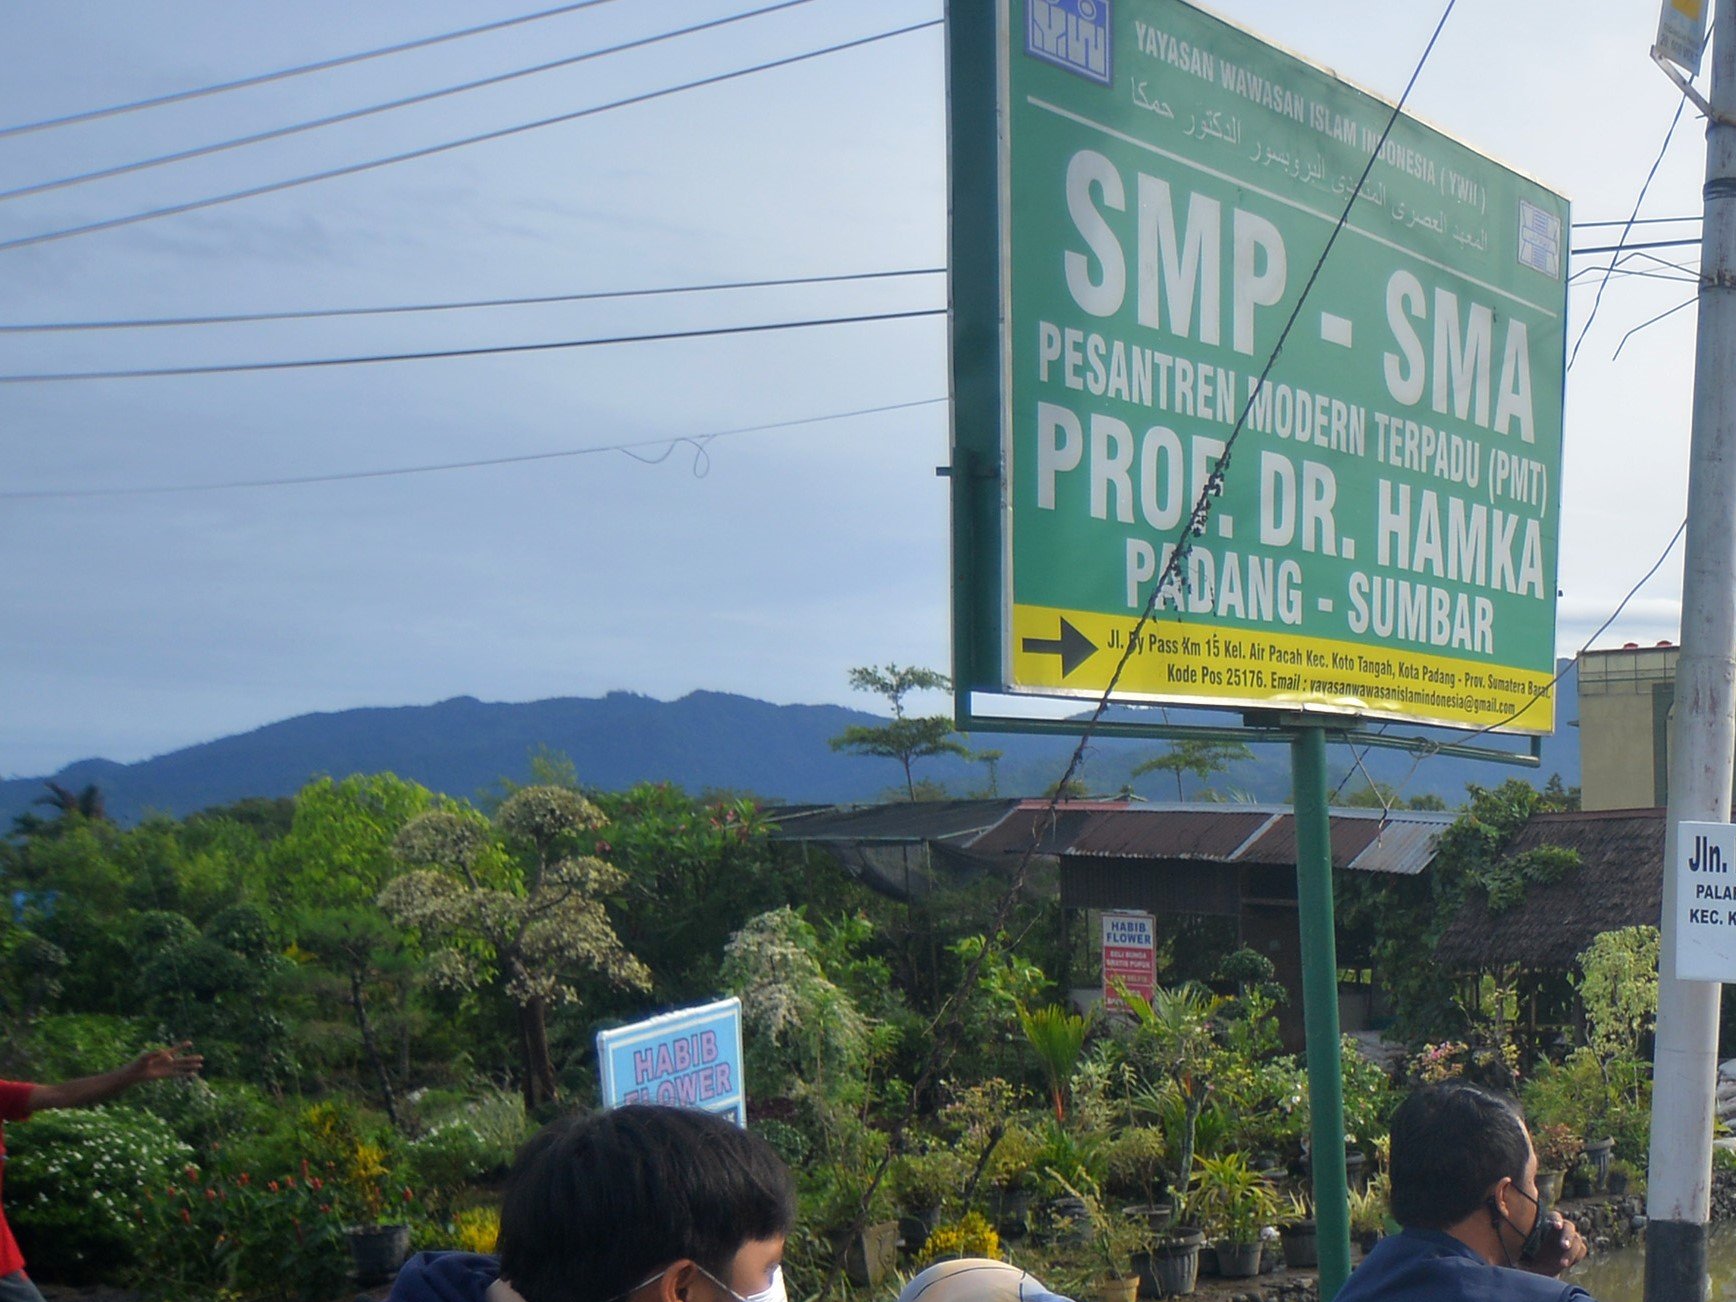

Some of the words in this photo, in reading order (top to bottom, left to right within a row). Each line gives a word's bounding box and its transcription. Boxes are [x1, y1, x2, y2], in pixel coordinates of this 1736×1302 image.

[1135, 21, 1214, 82] YAYASAN
[1220, 59, 1304, 123] WAWASAN
[1310, 102, 1357, 147] ISLAM
[1363, 128, 1435, 186] INDONESIA
[1064, 150, 1287, 356] SMP
[1384, 269, 1535, 444] SMA
[1039, 320, 1235, 425] PESANTREN
[1247, 376, 1366, 457] MODERN
[1374, 411, 1480, 488] TERPADU
[1488, 448, 1547, 518] (PMT)
[1037, 400, 1234, 539] PROF.
[1260, 450, 1355, 560] DR.
[1377, 478, 1545, 600] HAMKA
[1126, 538, 1302, 625] PADANG
[1348, 572, 1494, 655] SUMBAR
[1107, 629, 1124, 649] Jl.
[1149, 633, 1178, 654] Pass
[1183, 637, 1201, 657] Km
[1205, 638, 1220, 658] 15
[1224, 640, 1246, 660] Kel.
[1250, 642, 1265, 661] Air
[1269, 643, 1302, 666] Pacah
[1306, 649, 1328, 669] Kec.
[1331, 652, 1354, 671] Koto
[1358, 656, 1396, 681] Tangah,
[1398, 661, 1420, 680] Kota
[1422, 665, 1456, 687] Padang
[1465, 671, 1486, 690] Prov.
[1487, 673, 1526, 695] Sumatera
[1167, 664, 1197, 683] Kode
[1201, 666, 1222, 686] Pos
[1226, 670, 1267, 689] 25176.
[1271, 672, 1301, 692] Email
[1689, 835, 1728, 874] Jln.
[1106, 932, 1151, 944] FLOWER
[1111, 921, 1146, 932] HABIB
[1689, 908, 1724, 926] KEC.
[634, 1029, 718, 1085] HABIB
